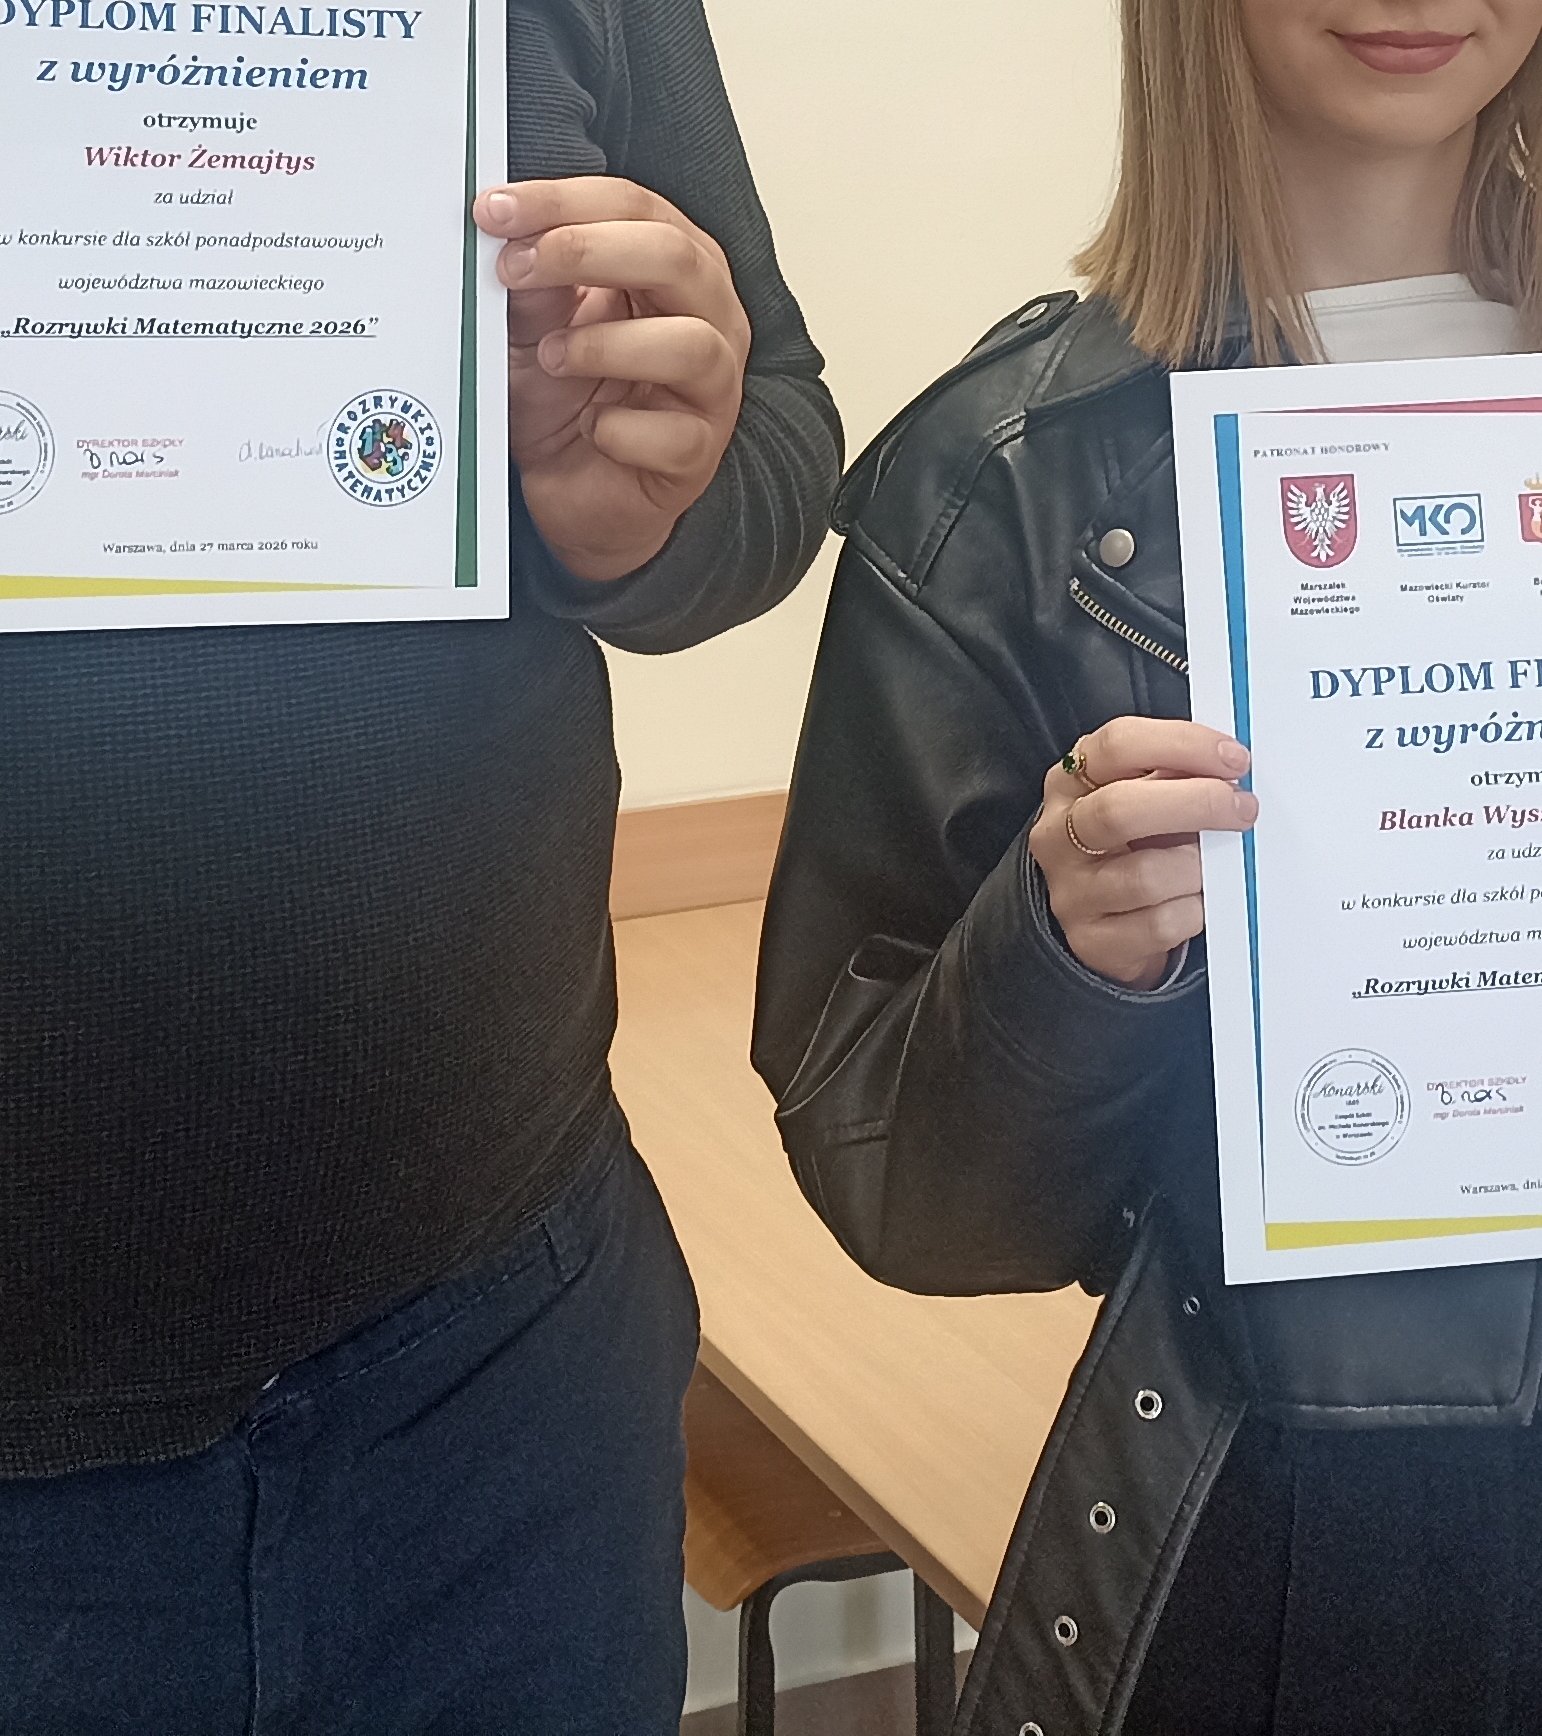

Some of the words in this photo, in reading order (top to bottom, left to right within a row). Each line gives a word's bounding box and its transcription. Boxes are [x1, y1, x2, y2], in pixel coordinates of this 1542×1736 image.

[191, 3, 422, 39] FINALISTY
[36, 60, 58, 82] z
[70, 53, 368, 92] wyróżnieniem
[143, 112, 258, 134] otrzymuje
[85, 145, 182, 168] Wiktor
[187, 144, 315, 176] Żemajtys
[179, 188, 234, 205] udział
[18, 228, 108, 246] konkursie
[112, 230, 141, 247] dla
[195, 231, 383, 253] ponadpodstawowych
[58, 273, 183, 293] województwa
[189, 274, 325, 295] mazowieckiego
[0, 317, 128, 339] „Rozrywki
[132, 317, 304, 339] Matematyczne
[309, 317, 379, 336] 2026”
[337, 395, 433, 435] ROZRYWKI
[334, 449, 436, 502] MATEMATYCZNE
[1399, 502, 1476, 536] MKO
[1309, 661, 1494, 700] DYPLOM
[1365, 728, 1384, 749] z
[1379, 806, 1474, 831] Blanka
[1450, 888, 1477, 905] dla
[1483, 884, 1525, 903] szkół
[1402, 929, 1521, 951] województwa
[1351, 972, 1471, 1000] „Rozrywki
